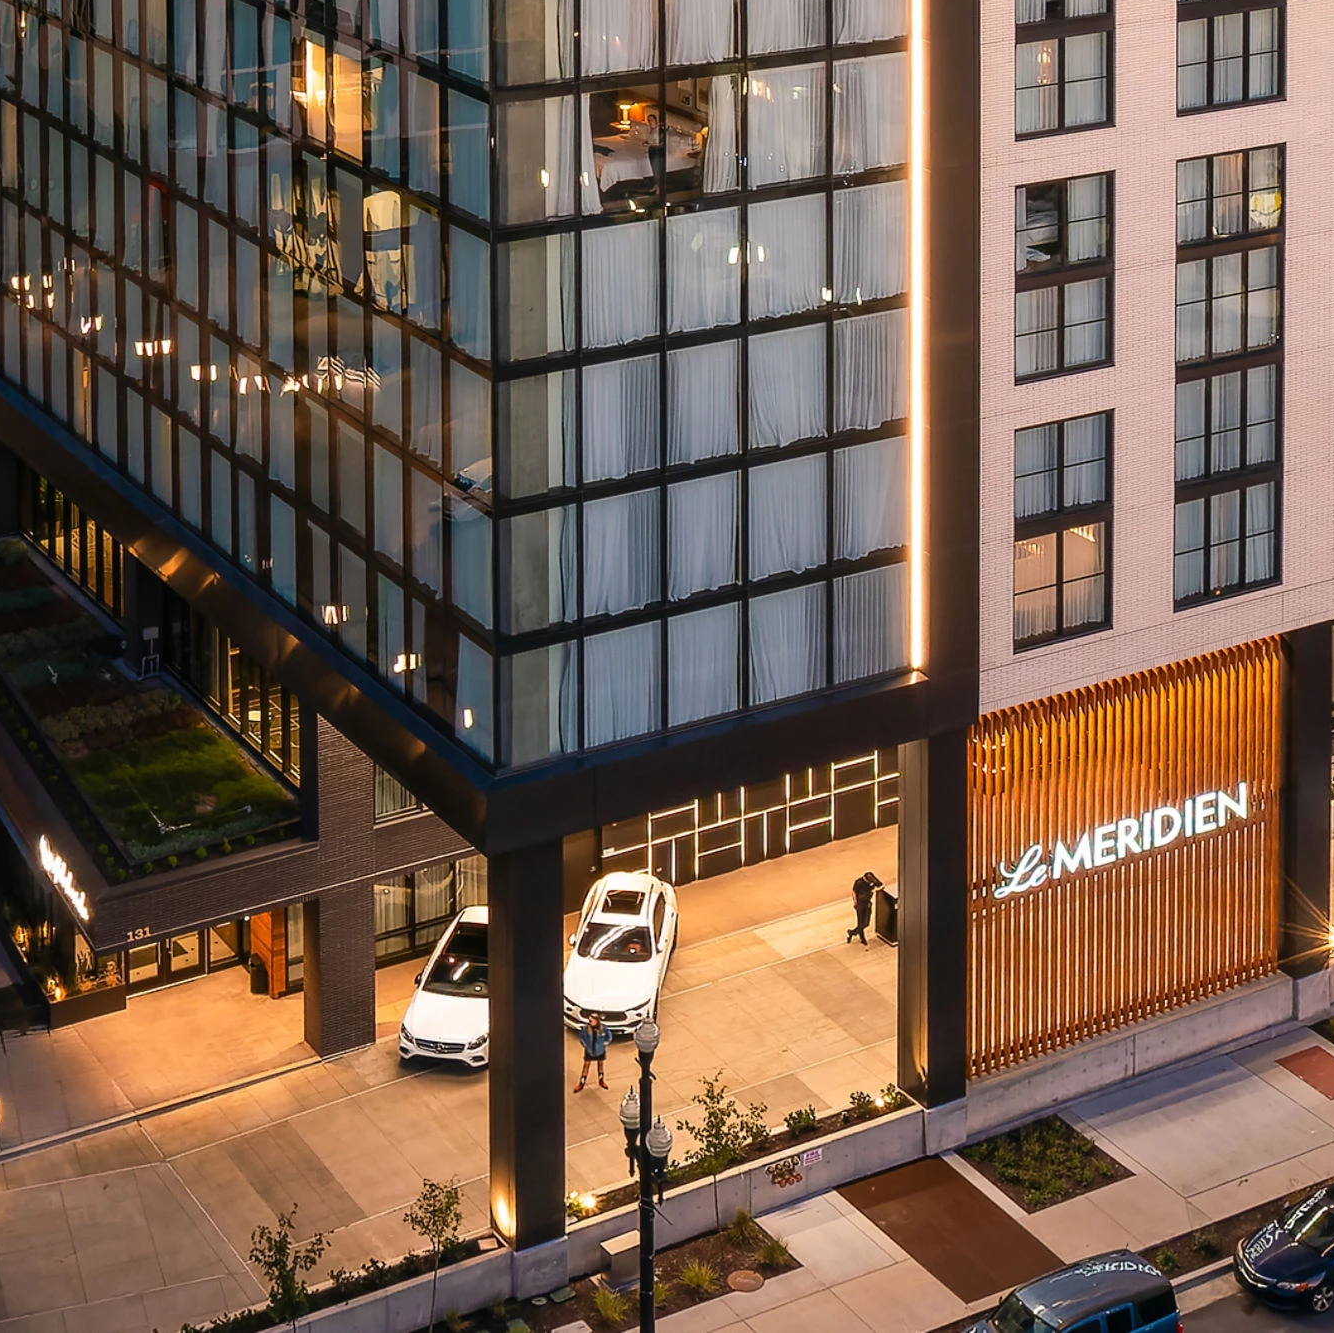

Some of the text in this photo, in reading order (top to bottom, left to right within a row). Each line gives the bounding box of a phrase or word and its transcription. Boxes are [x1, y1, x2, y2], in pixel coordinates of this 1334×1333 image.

[994, 781, 1248, 899] Le MERIDIEN
[127, 926, 151, 942] 131
